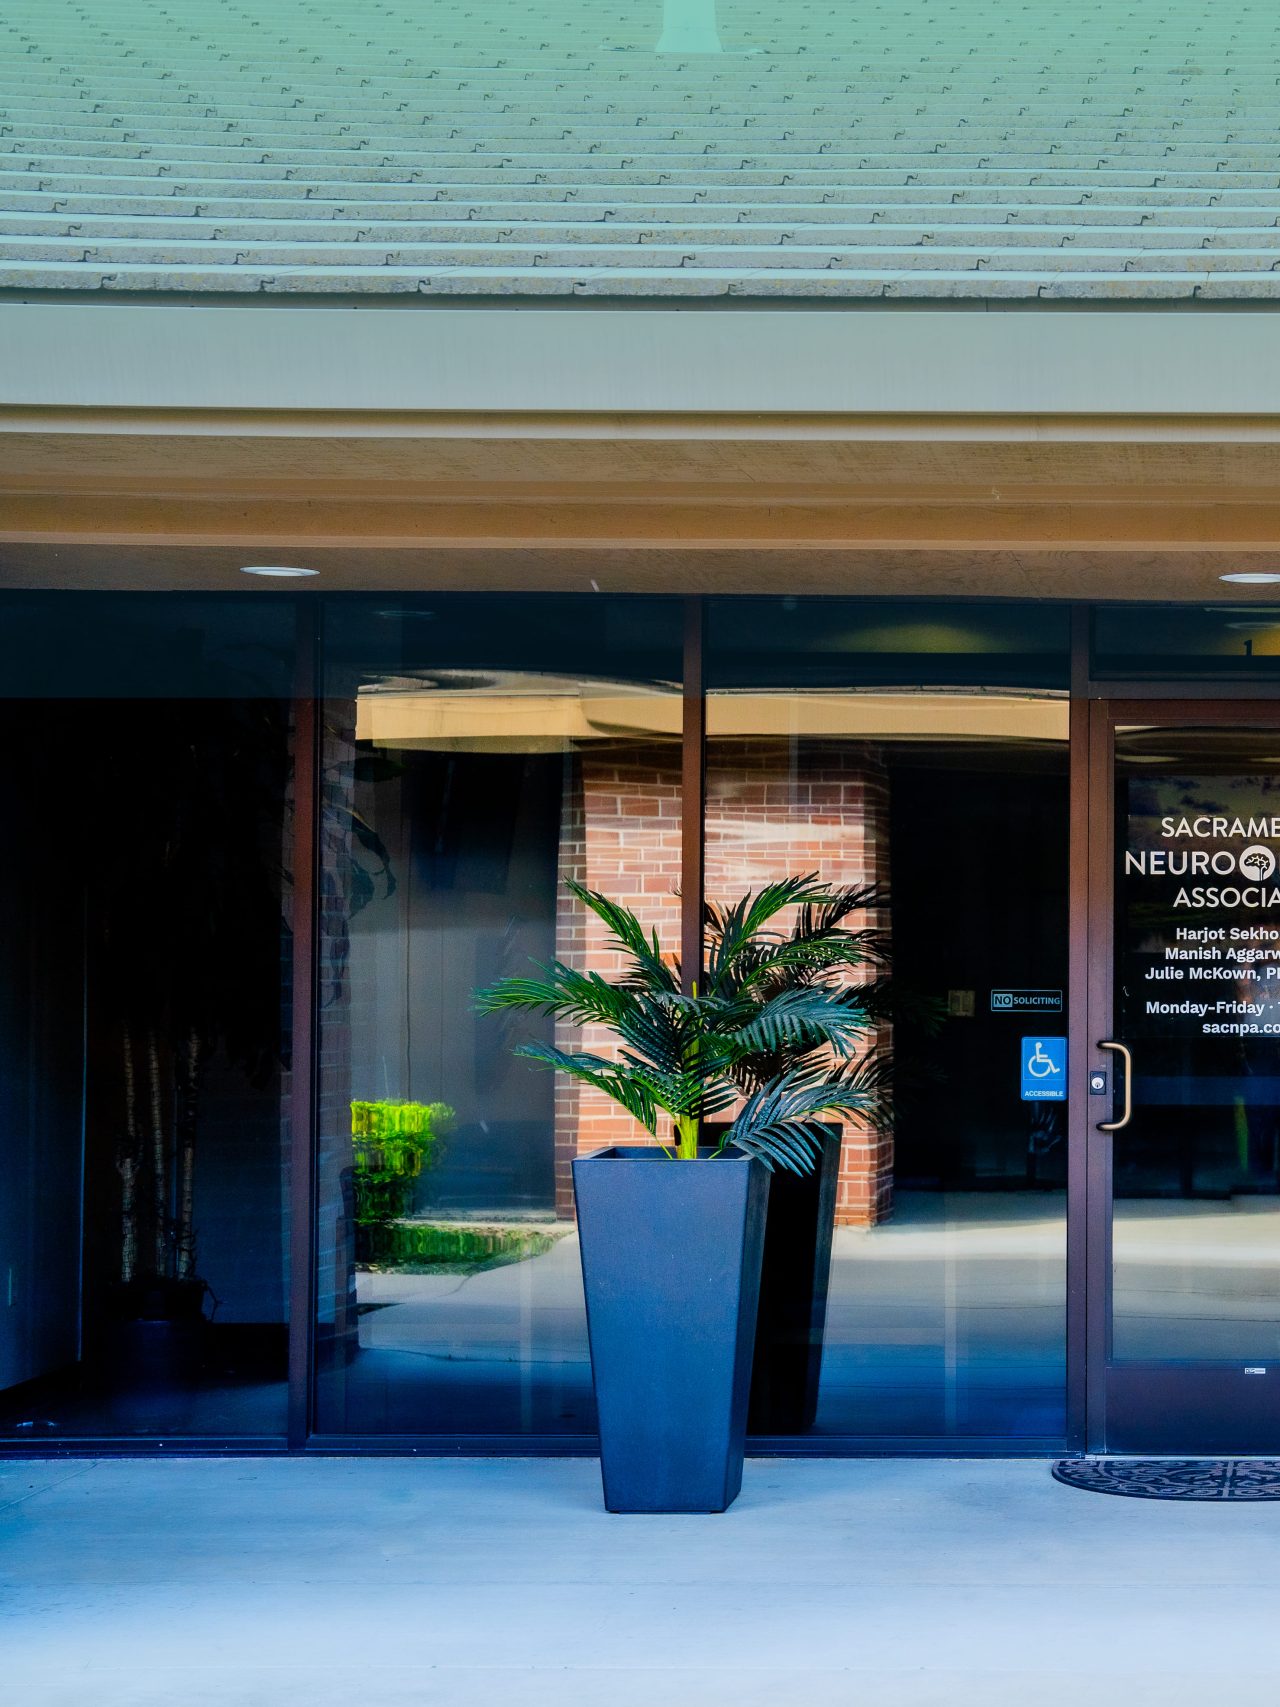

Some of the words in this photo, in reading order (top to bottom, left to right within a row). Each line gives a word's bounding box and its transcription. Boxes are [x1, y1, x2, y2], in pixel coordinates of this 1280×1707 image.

[1125, 850, 1236, 875] NEURO
[1176, 926, 1226, 943] Harjot
[1165, 946, 1222, 960] Manish
[1145, 966, 1184, 980] Julie
[1189, 966, 1261, 981] McKown,
[993, 994, 1012, 1006] NO
[1014, 996, 1060, 1005] SOLICITING
[1146, 1001, 1264, 1016] Monday-Friday
